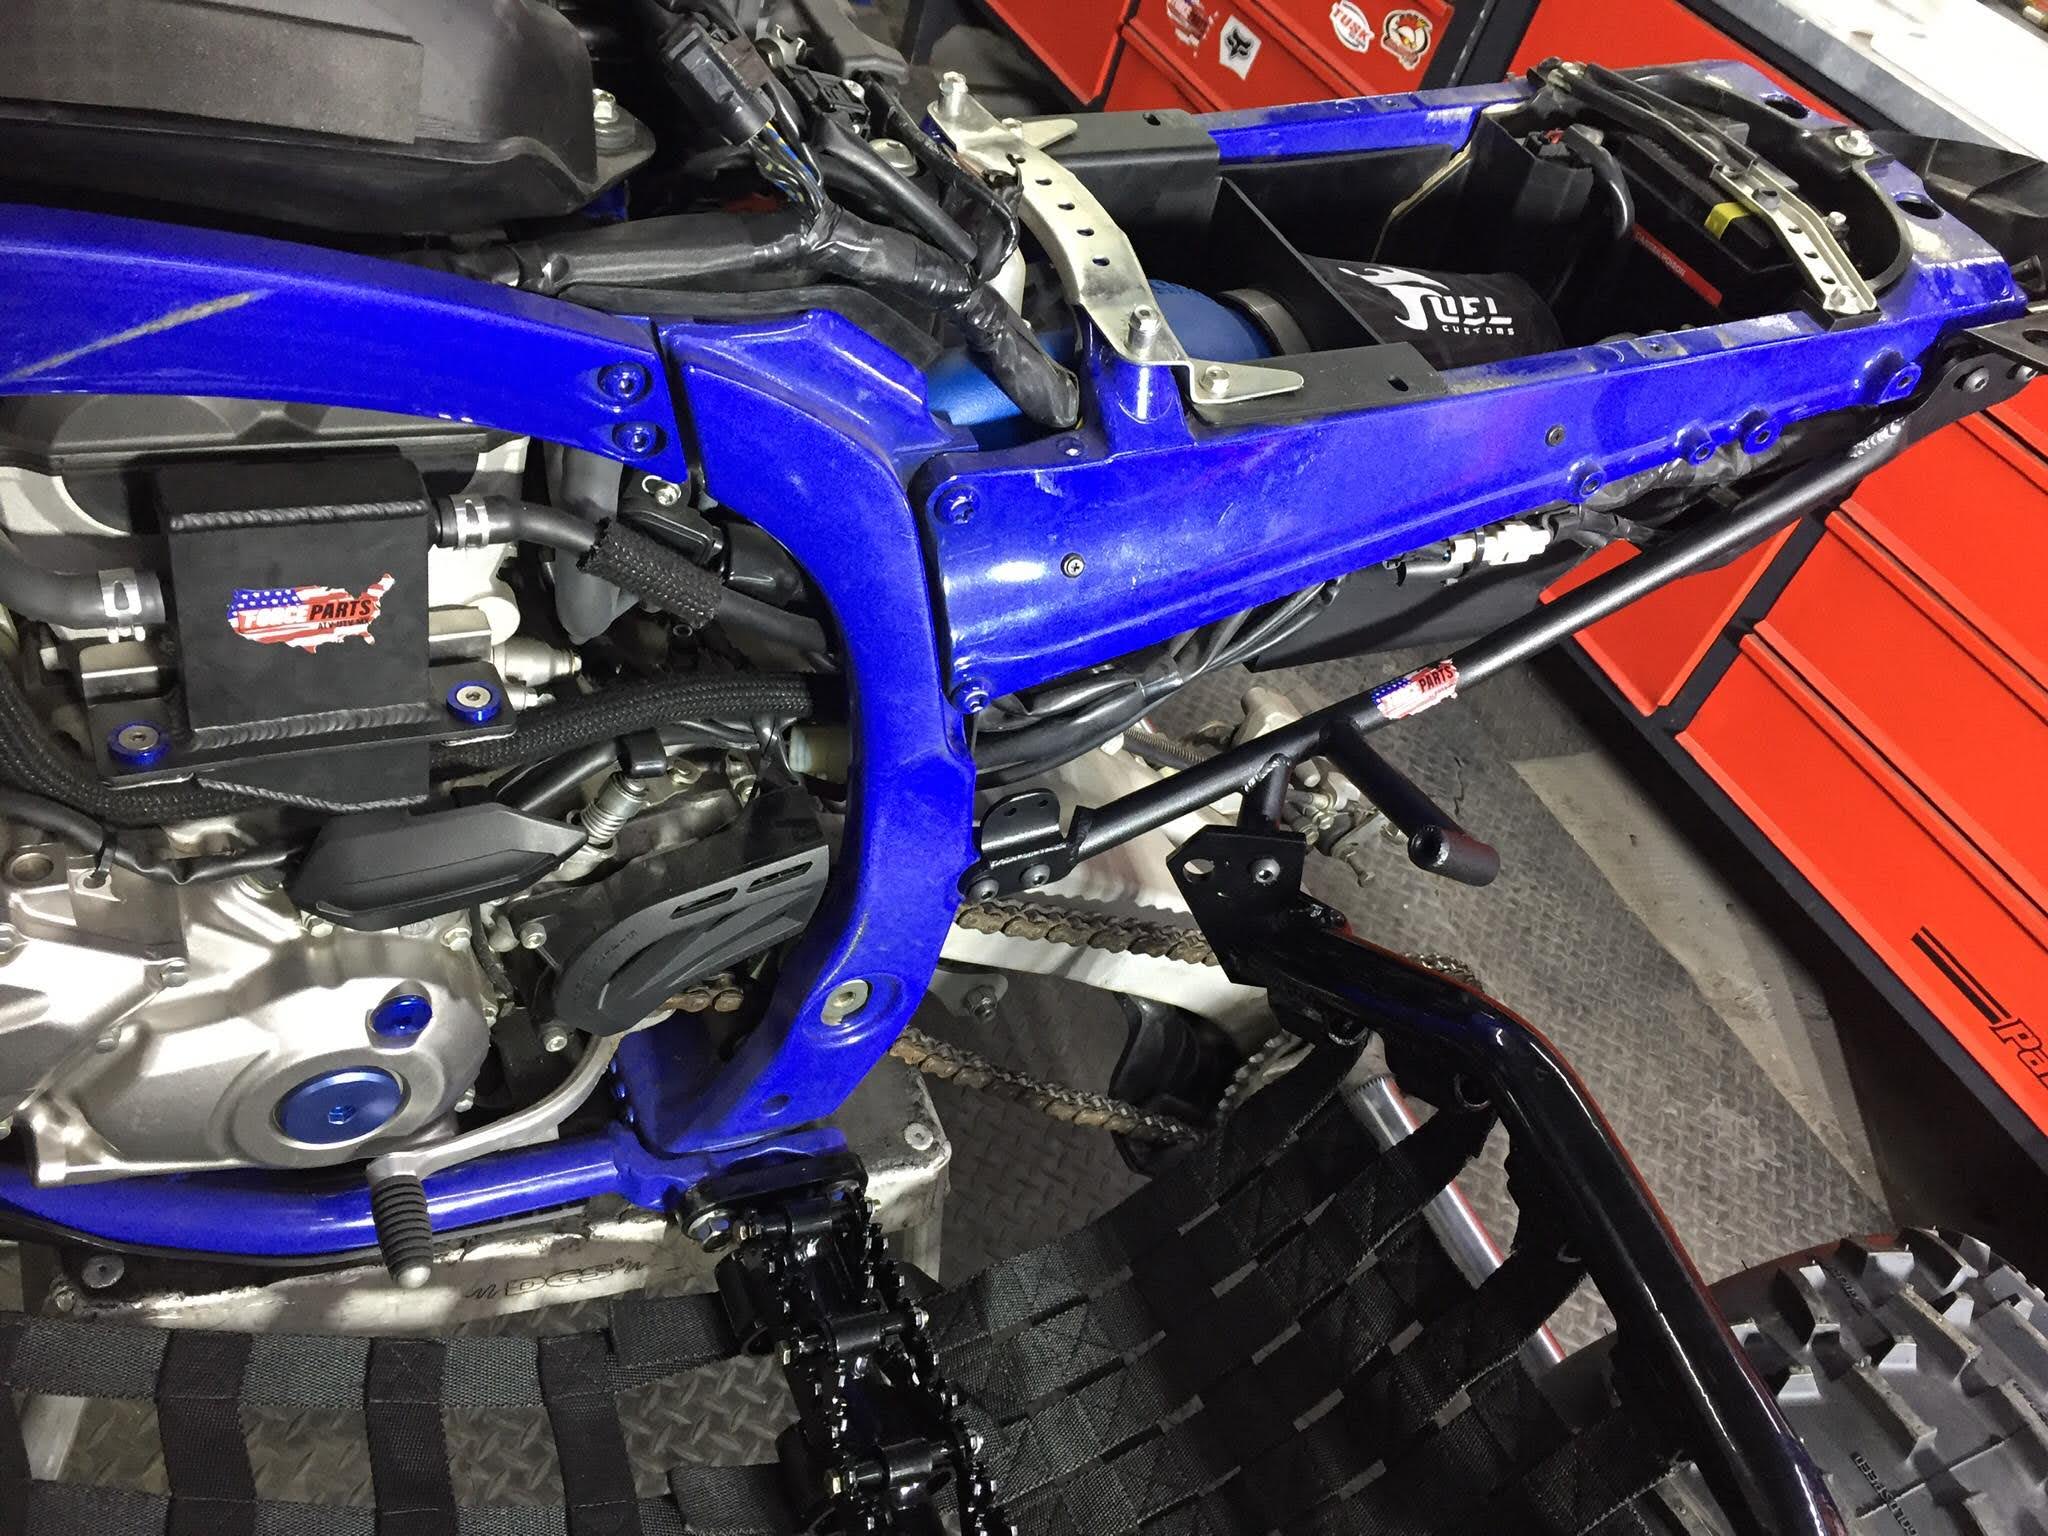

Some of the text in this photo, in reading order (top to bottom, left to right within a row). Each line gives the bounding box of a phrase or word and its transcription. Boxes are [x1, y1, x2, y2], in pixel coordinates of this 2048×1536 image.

[1332, 6, 1370, 41] TUSK
[1441, 324, 1515, 336] CUSTOMS
[309, 599, 372, 621] PARTS
[1419, 665, 1454, 693] PARTS
